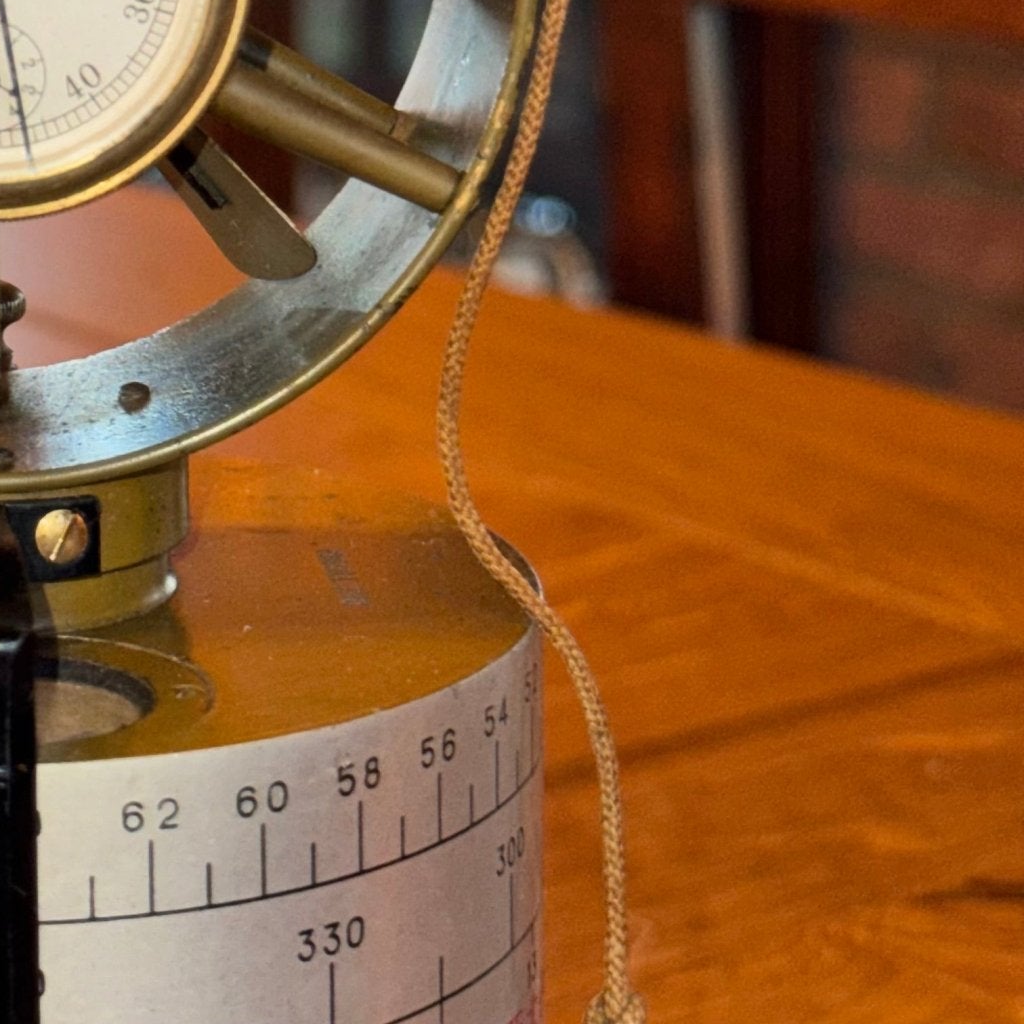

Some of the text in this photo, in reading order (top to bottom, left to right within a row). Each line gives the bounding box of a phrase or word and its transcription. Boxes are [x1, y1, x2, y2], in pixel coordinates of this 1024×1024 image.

[66, 63, 101, 100] 40
[484, 696, 508, 738] 54
[421, 728, 456, 769] 56
[337, 756, 380, 797] 58
[122, 797, 179, 833] 62
[236, 780, 288, 818] 60
[496, 827, 524, 876] 300
[297, 916, 365, 962] 330
